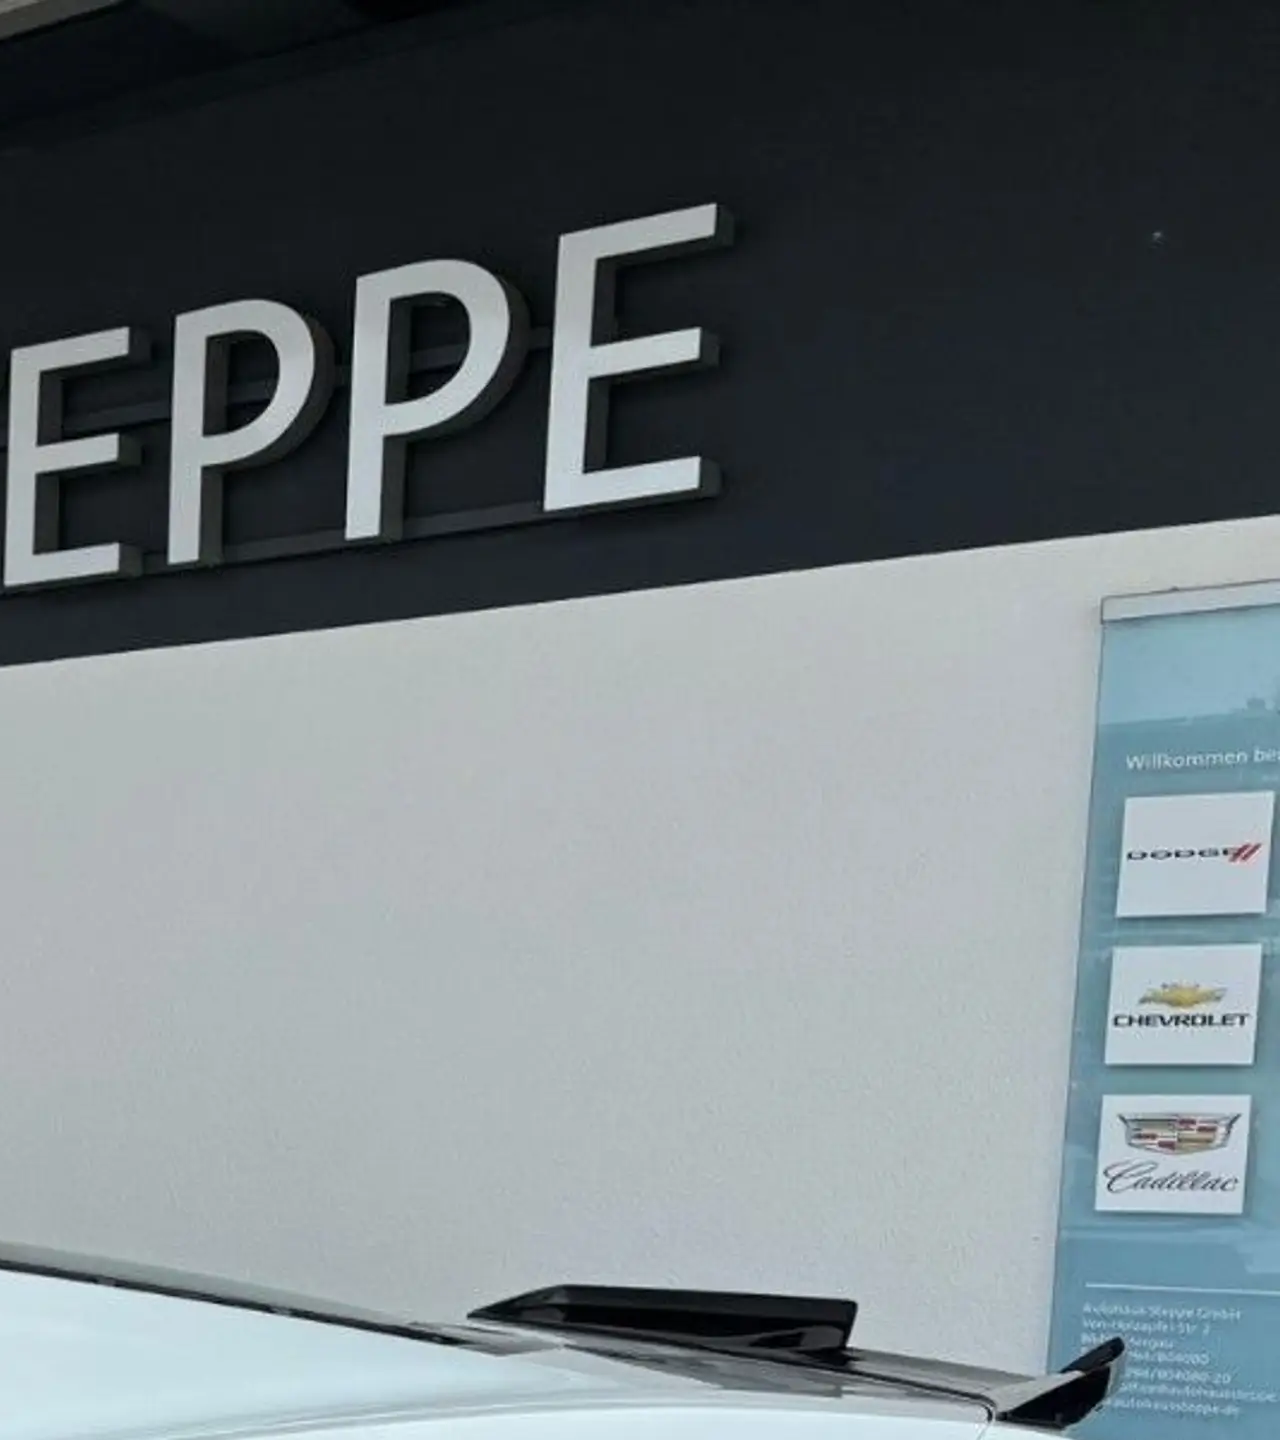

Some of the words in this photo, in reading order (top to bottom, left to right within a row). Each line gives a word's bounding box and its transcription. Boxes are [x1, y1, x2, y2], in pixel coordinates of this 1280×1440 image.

[1125, 750, 1248, 770] Willkommen
[1113, 1013, 1250, 1028] CHEVROLET
[1102, 1158, 1239, 1194] Cadillac
